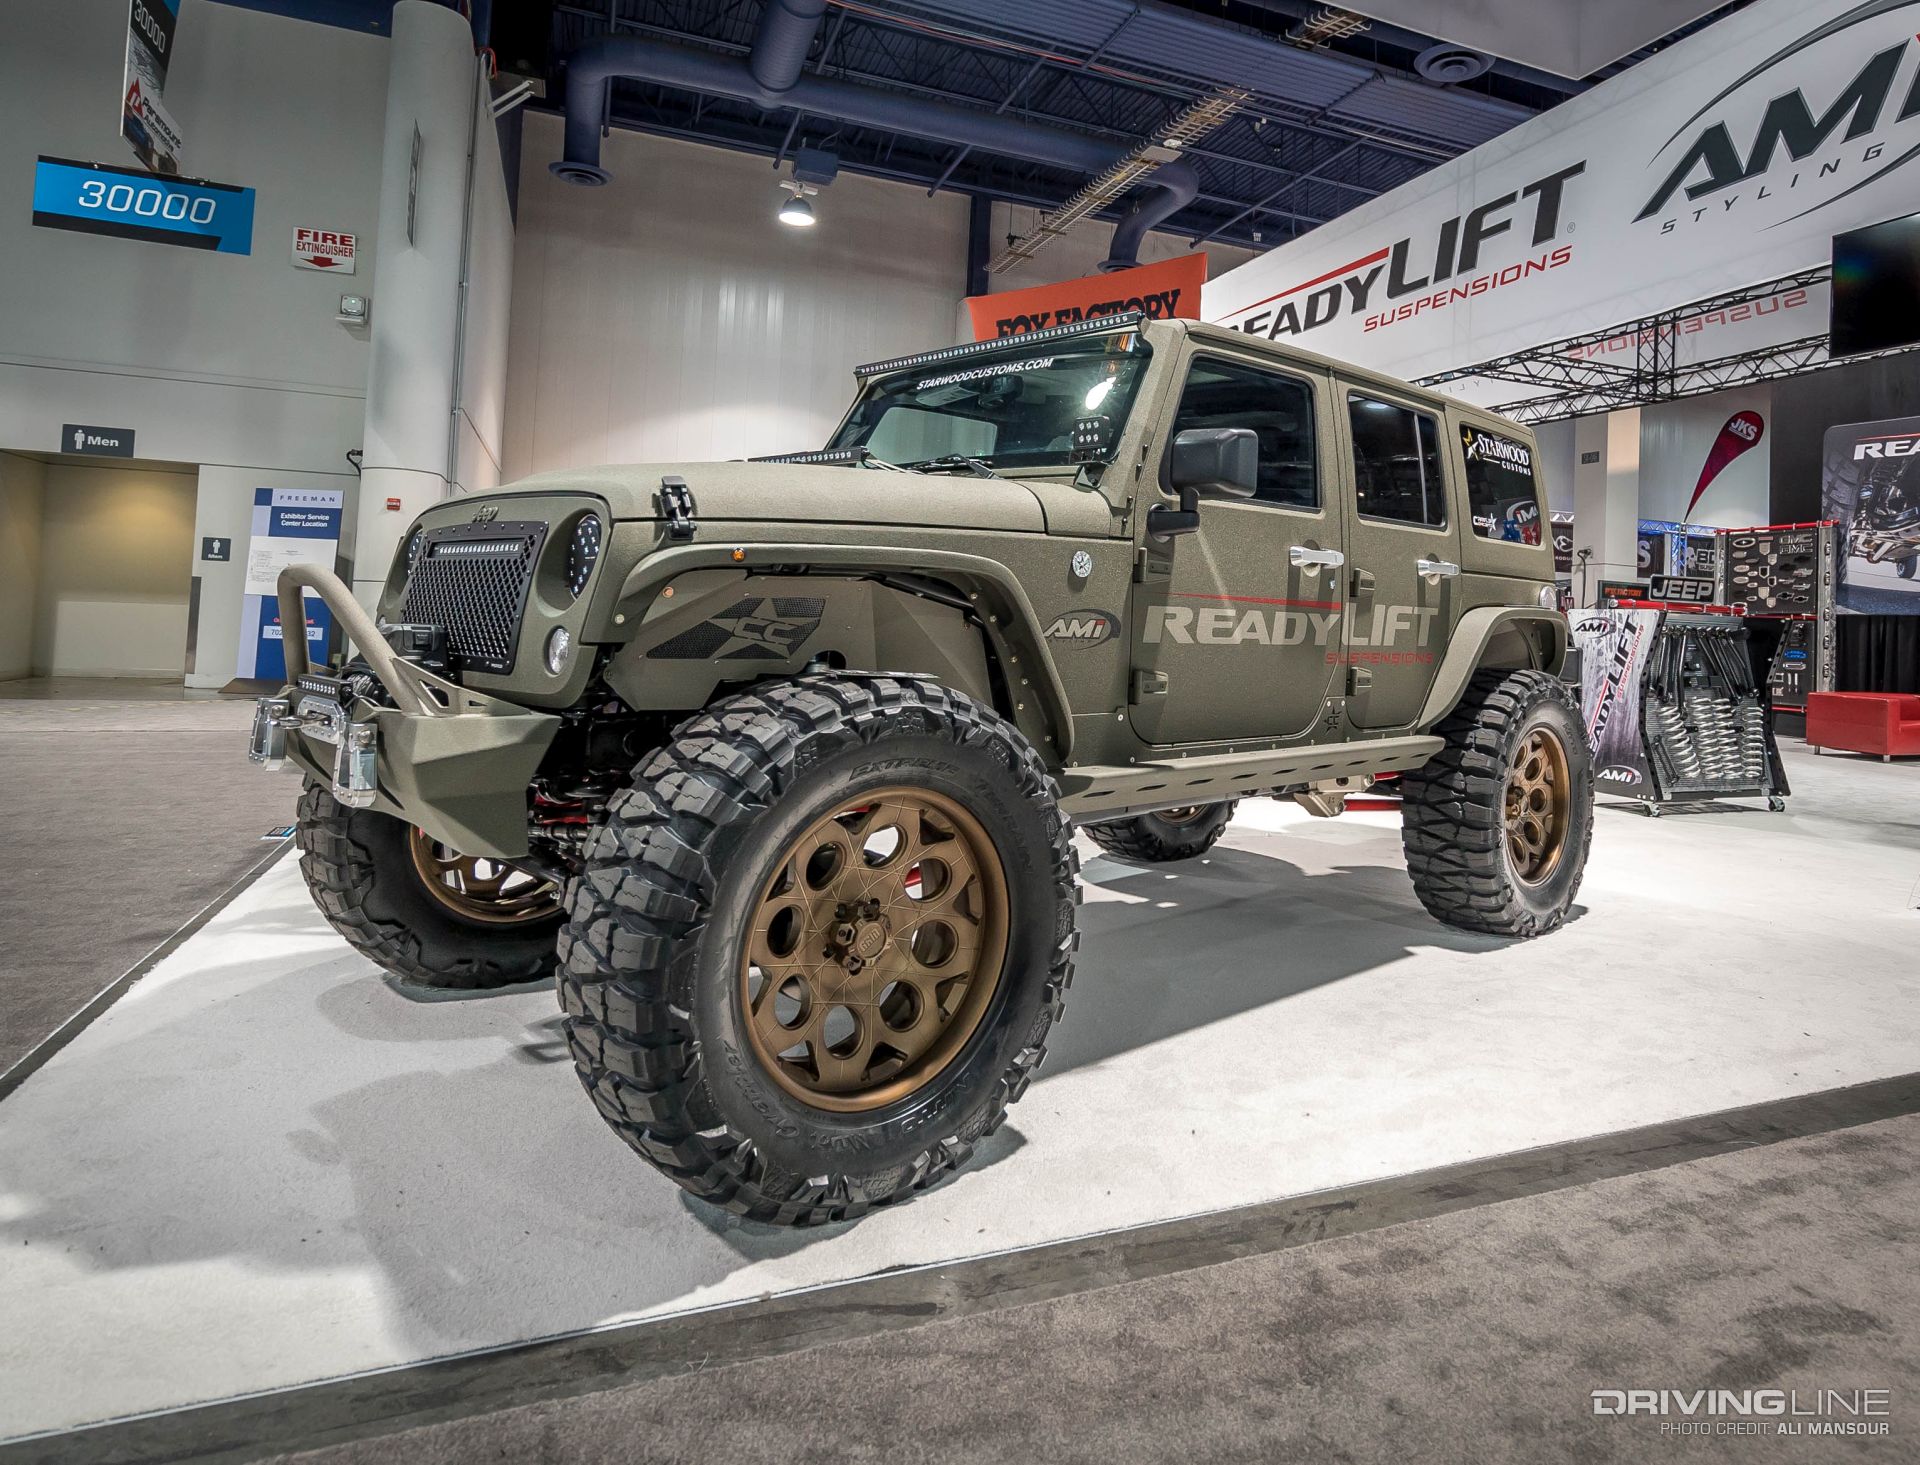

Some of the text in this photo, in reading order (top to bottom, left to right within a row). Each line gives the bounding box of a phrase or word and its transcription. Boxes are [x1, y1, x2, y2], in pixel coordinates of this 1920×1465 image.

[142, 96, 182, 149] Paramount
[1660, 142, 1885, 235] STYLING
[78, 180, 217, 225] 30000
[296, 240, 354, 258] EXTINGUISHER
[297, 229, 354, 247] FIRE
[1228, 159, 1587, 341] EADYLIFT
[1363, 245, 1573, 333] SUSPENSIONS
[916, 357, 1054, 391] STARWOODCUSTOMS.COM
[1731, 418, 1757, 440] JKS
[87, 435, 119, 447] Men
[1477, 433, 1529, 466] STARWOOD
[1501, 461, 1532, 476] CUSTOMS
[280, 495, 336, 503] FREEMAN
[280, 513, 330, 521] Exhibitor Service
[302, 520, 328, 528] Location
[1652, 579, 1713, 600] JEEP
[1141, 601, 1439, 648] READYLIFT
